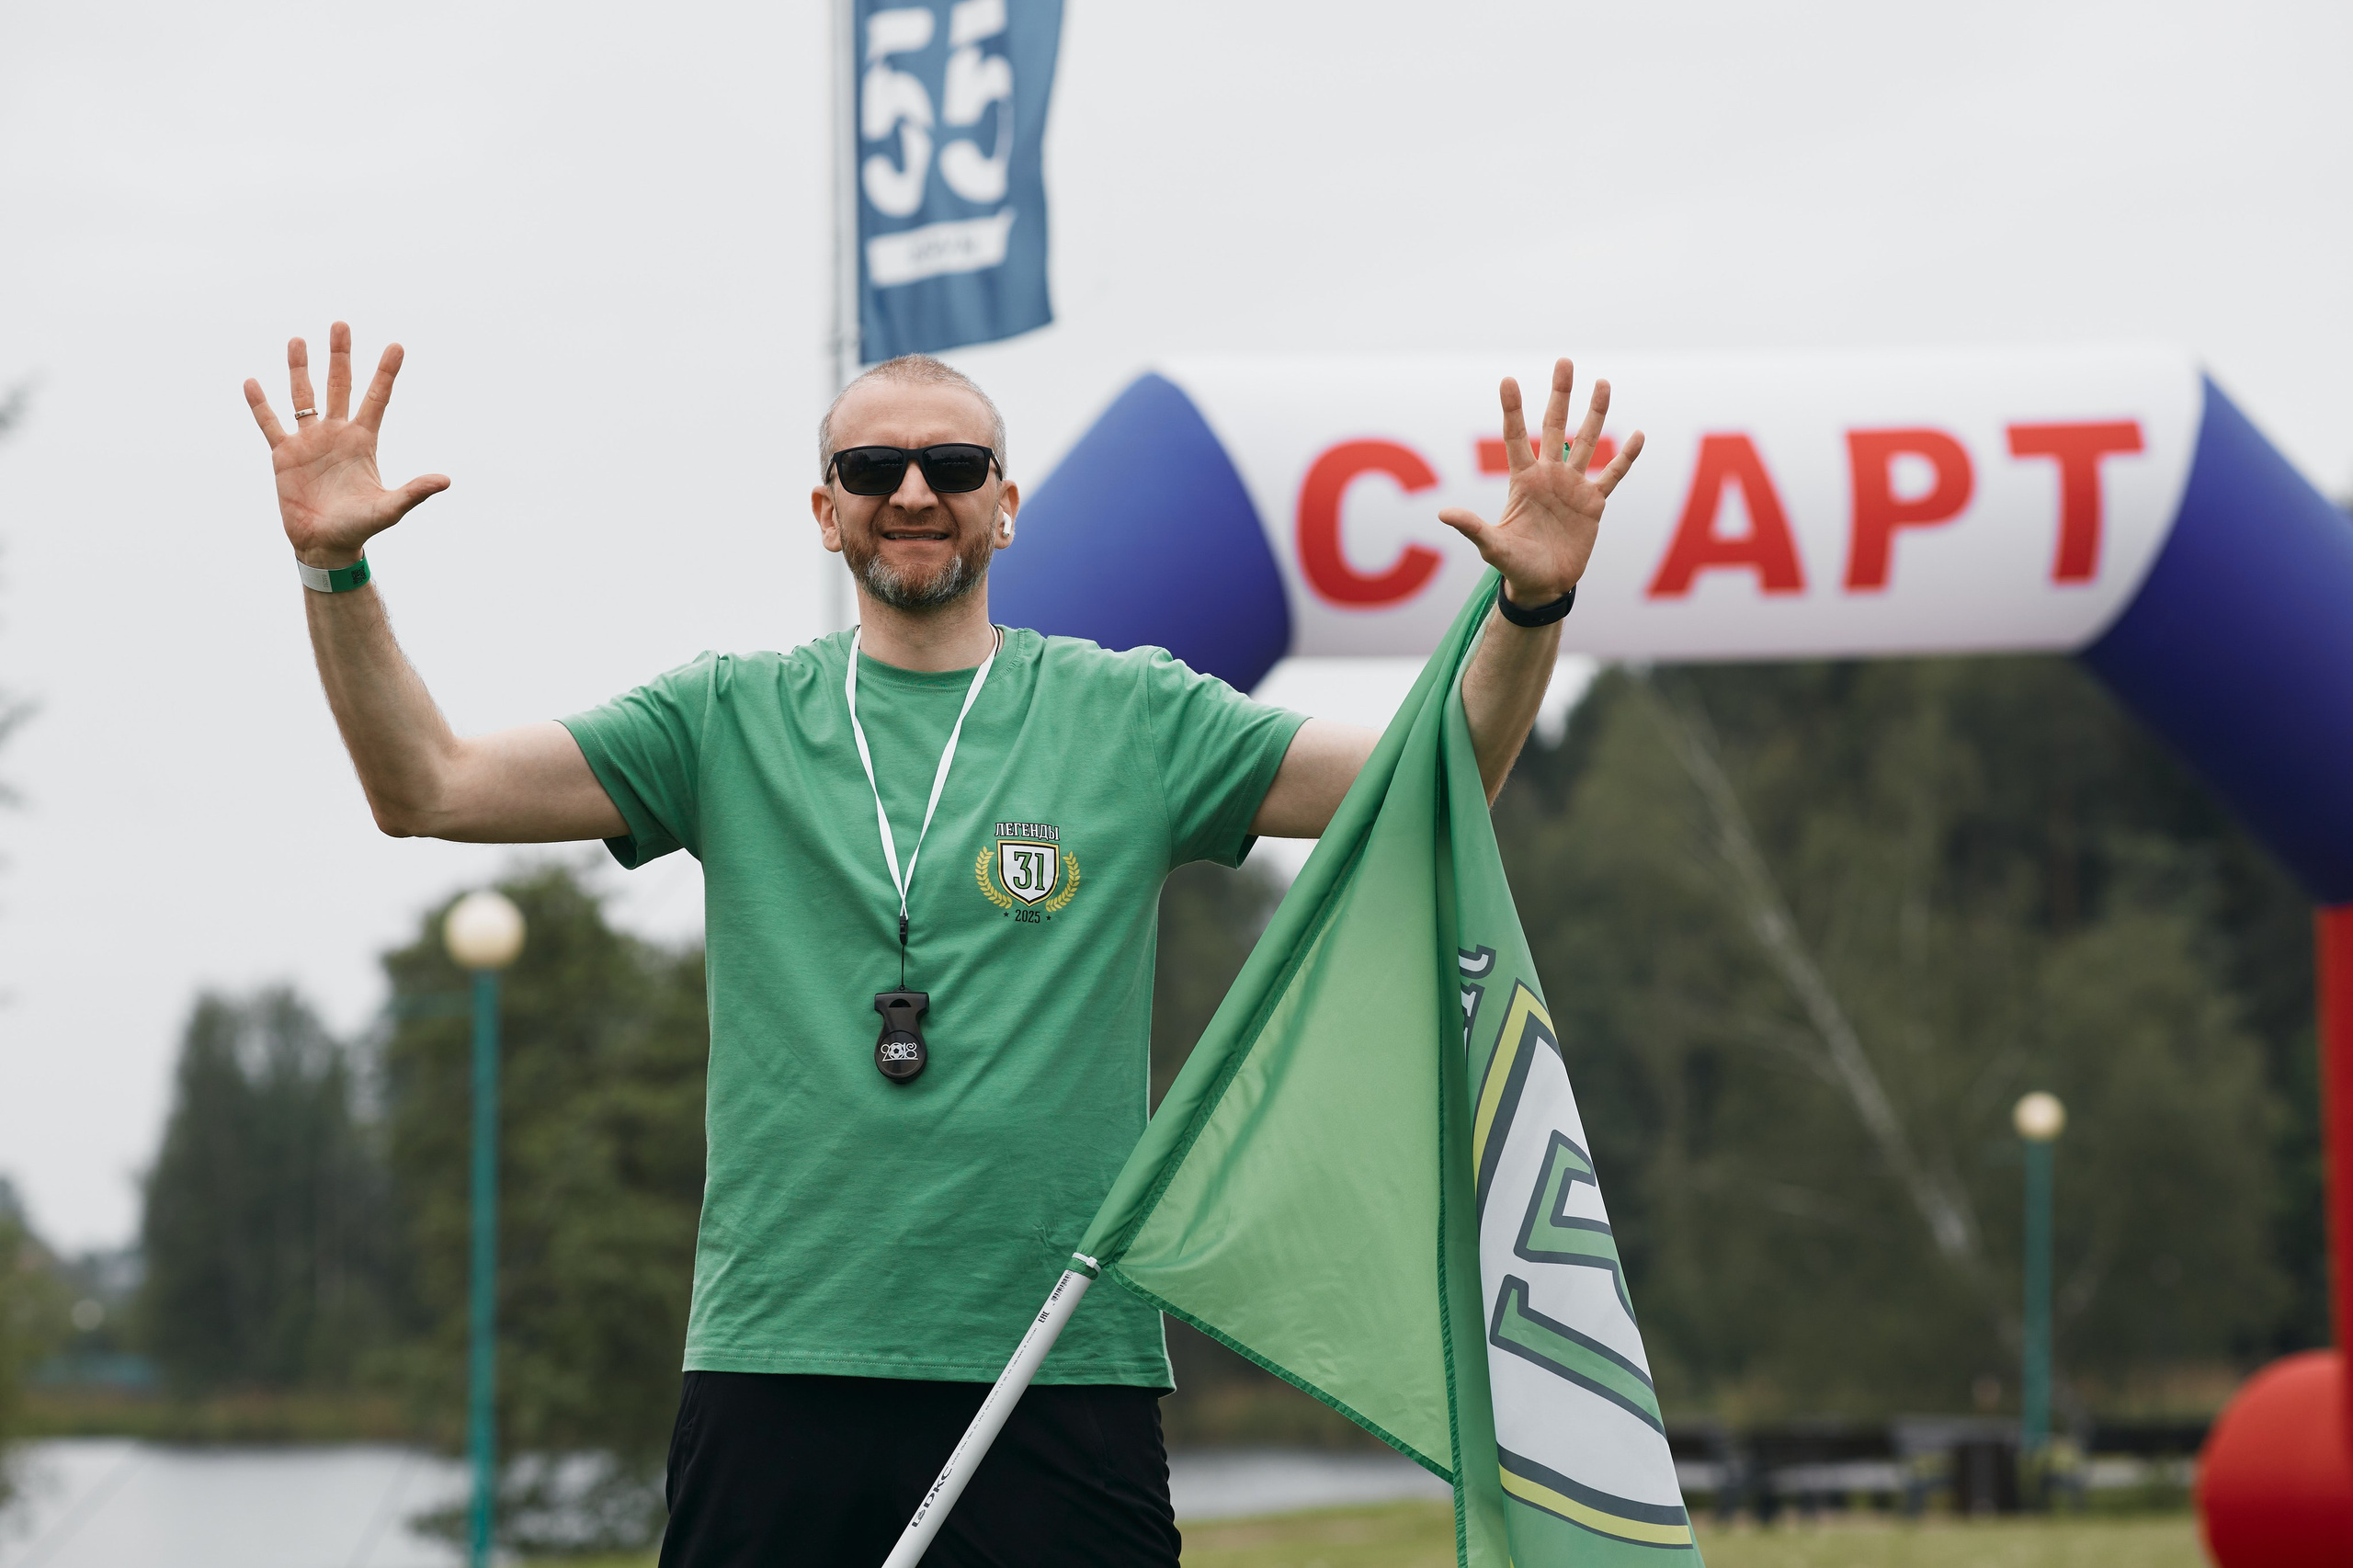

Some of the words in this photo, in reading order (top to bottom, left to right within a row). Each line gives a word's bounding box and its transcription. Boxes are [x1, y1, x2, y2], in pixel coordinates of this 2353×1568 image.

[862, 0, 1014, 218] 55
[995, 823, 1061, 841] ЛЕГЕНДЫ
[1013, 851, 1045, 891] 31
[1015, 909, 1041, 924] 2025
[922, 1465, 953, 1509] DKC
